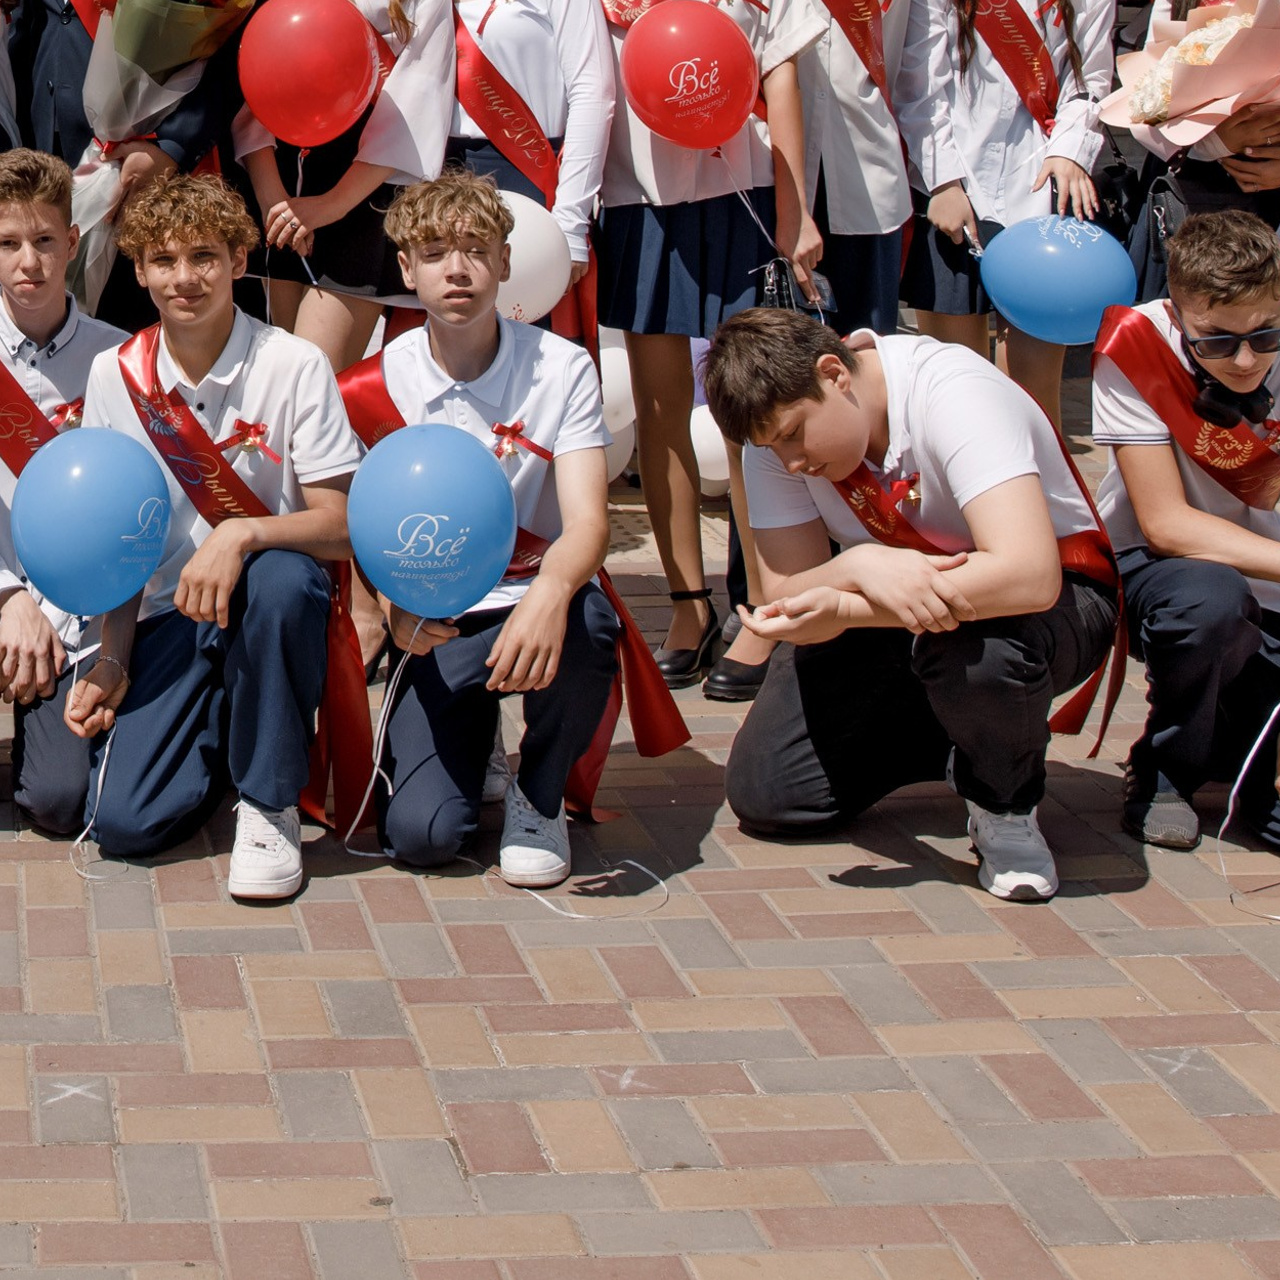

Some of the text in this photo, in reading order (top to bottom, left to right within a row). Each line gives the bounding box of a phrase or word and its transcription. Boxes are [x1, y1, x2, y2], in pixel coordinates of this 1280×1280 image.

[664, 57, 720, 102] Всё
[678, 85, 721, 108] только
[1210, 439, 1227, 457] класс
[383, 513, 470, 558] Всё
[399, 551, 460, 570] только
[390, 566, 470, 583] начинается!
